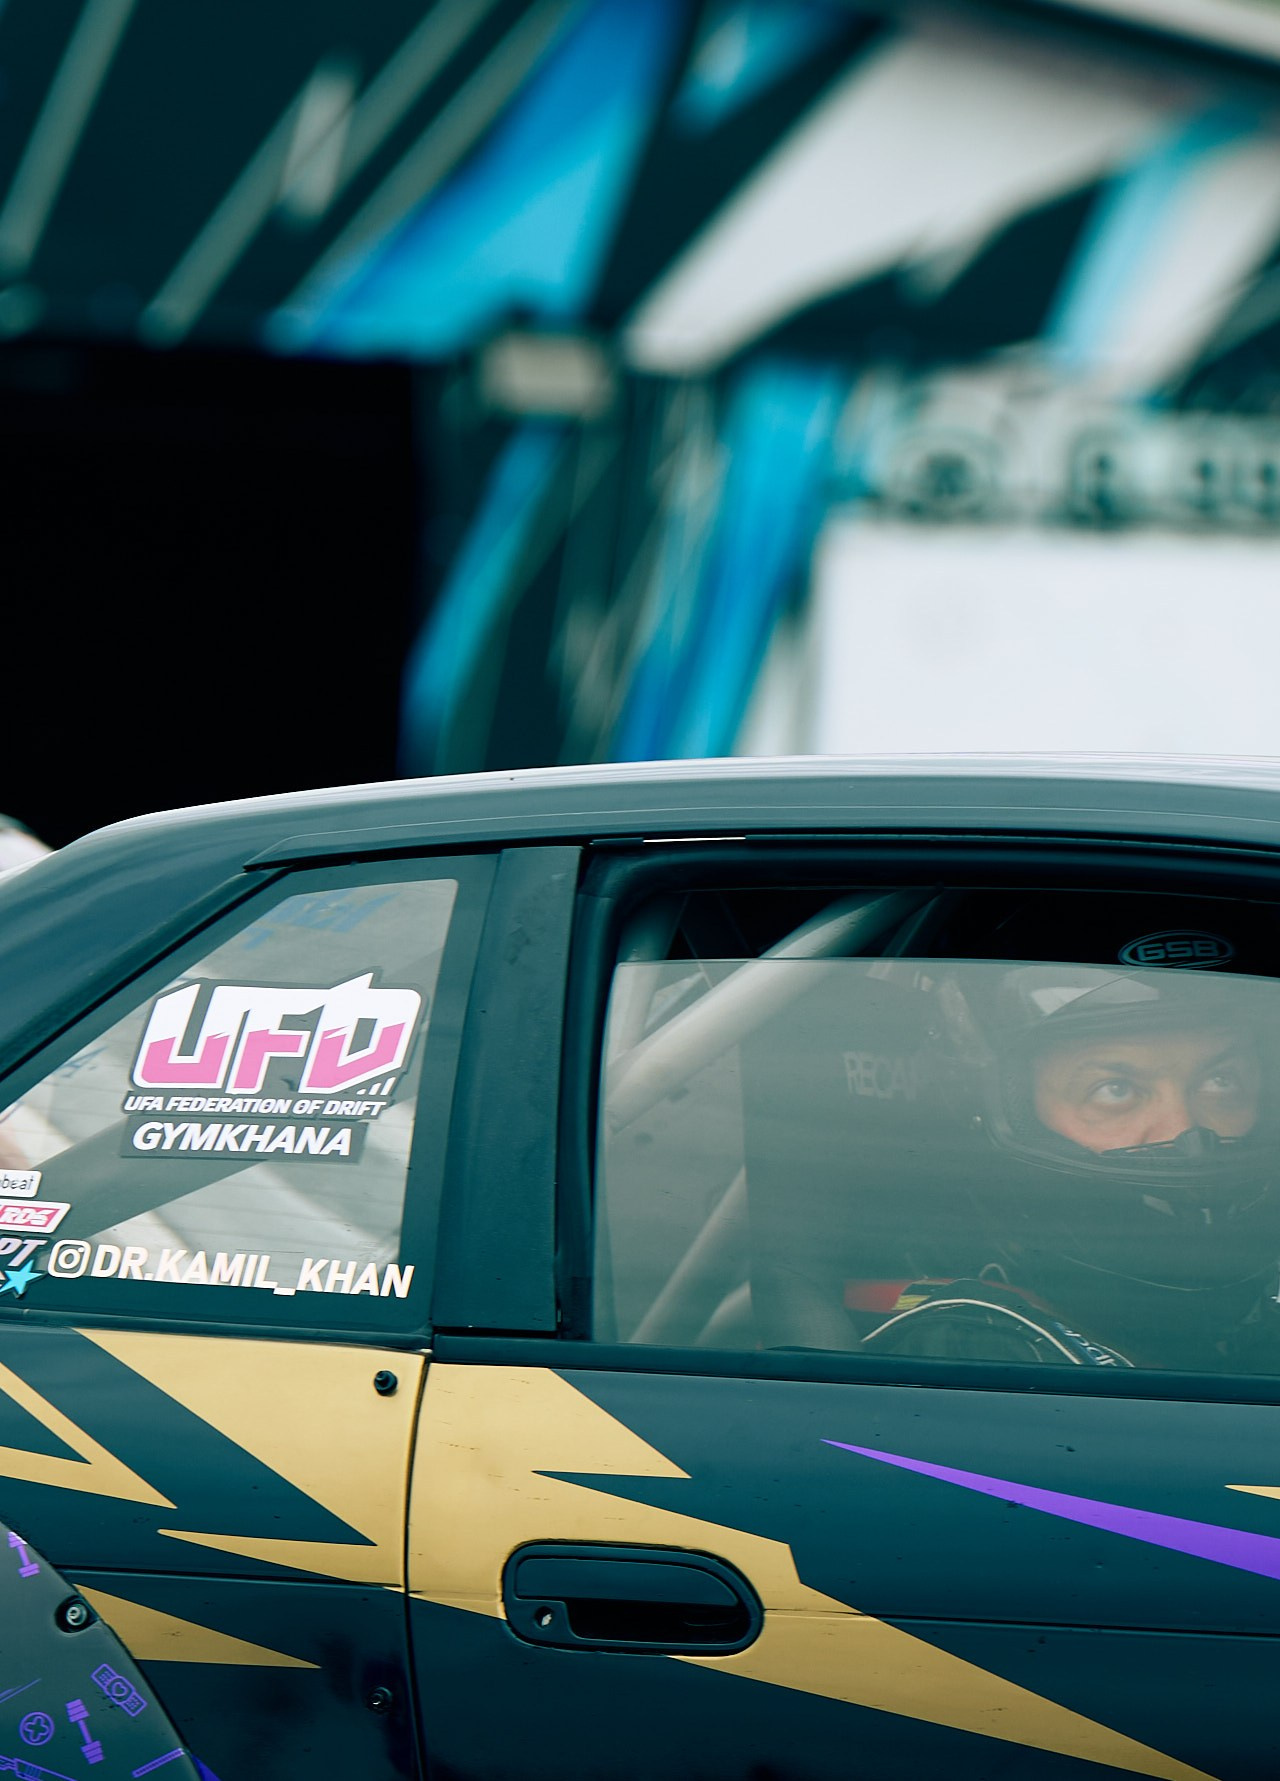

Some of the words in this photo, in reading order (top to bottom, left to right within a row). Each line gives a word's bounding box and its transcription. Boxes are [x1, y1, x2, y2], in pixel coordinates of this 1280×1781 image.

[133, 973, 421, 1095] UFD
[124, 1095, 163, 1112] UFA
[166, 1096, 292, 1115] FEDERATION
[292, 1098, 322, 1116] OF
[323, 1099, 387, 1117] DRIFT
[132, 1121, 352, 1156] GYMKHANA
[0, 1174, 34, 1191] beat
[91, 1244, 415, 1298] DR.KAMIL_KHAN
